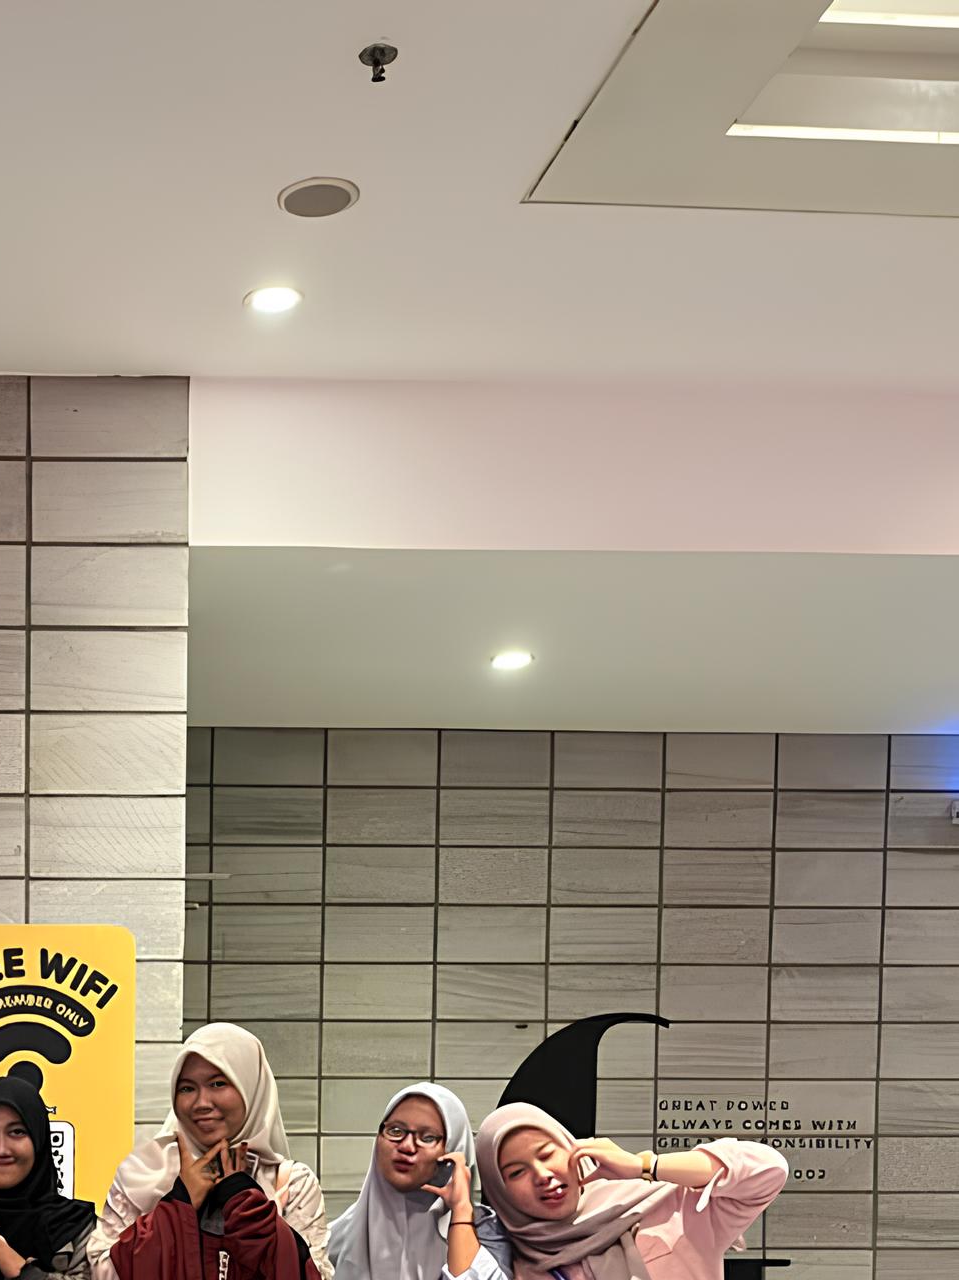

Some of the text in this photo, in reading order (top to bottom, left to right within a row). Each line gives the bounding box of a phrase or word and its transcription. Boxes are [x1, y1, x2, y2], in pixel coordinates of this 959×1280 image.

[39, 947, 119, 1010] WIFI
[56, 1003, 89, 1028] ONLY
[657, 1119, 857, 1130] ALWAYS COMES WITH
